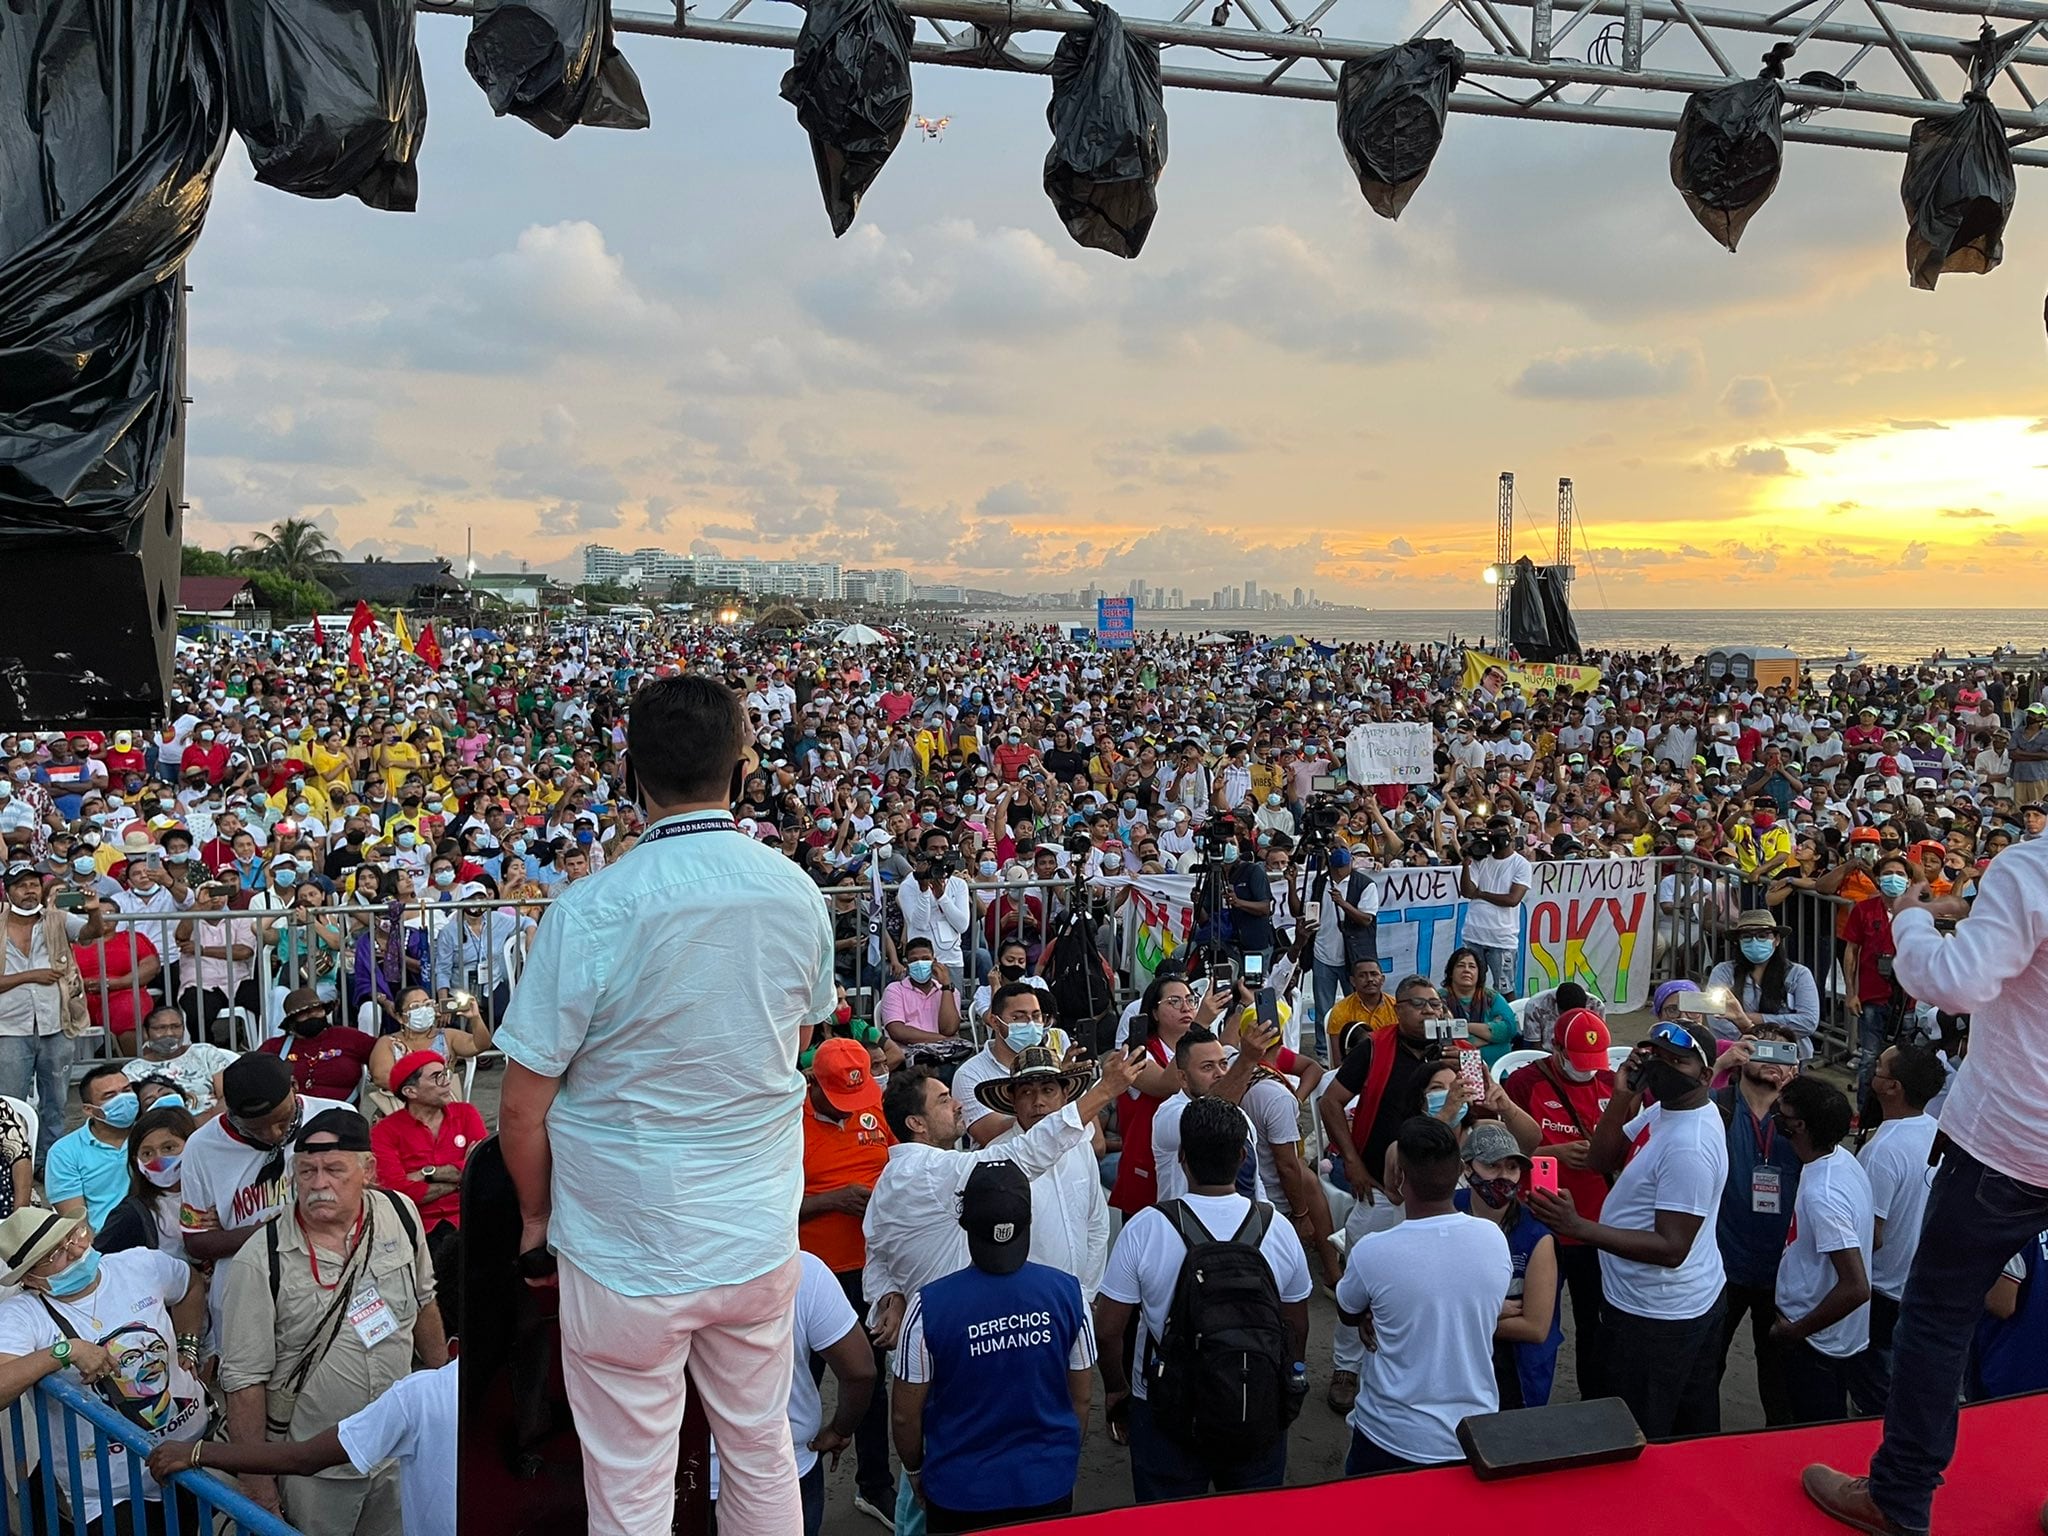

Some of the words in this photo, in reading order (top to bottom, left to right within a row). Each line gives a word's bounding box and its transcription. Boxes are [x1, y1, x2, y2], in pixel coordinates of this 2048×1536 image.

[1532, 663, 1581, 680] MARIA
[1253, 777, 1271, 787] VIBES
[1392, 766, 1421, 776] PETRO
[665, 825, 691, 835] UNIDAD
[692, 822, 721, 831] NACIONAL
[1533, 860, 1623, 896] RITMO
[1628, 859, 1650, 889] DE
[968, 1311, 1051, 1339] DERECHOS
[970, 1330, 1052, 1357] HUMANOS
[149, 1398, 200, 1438] TÓRICO
